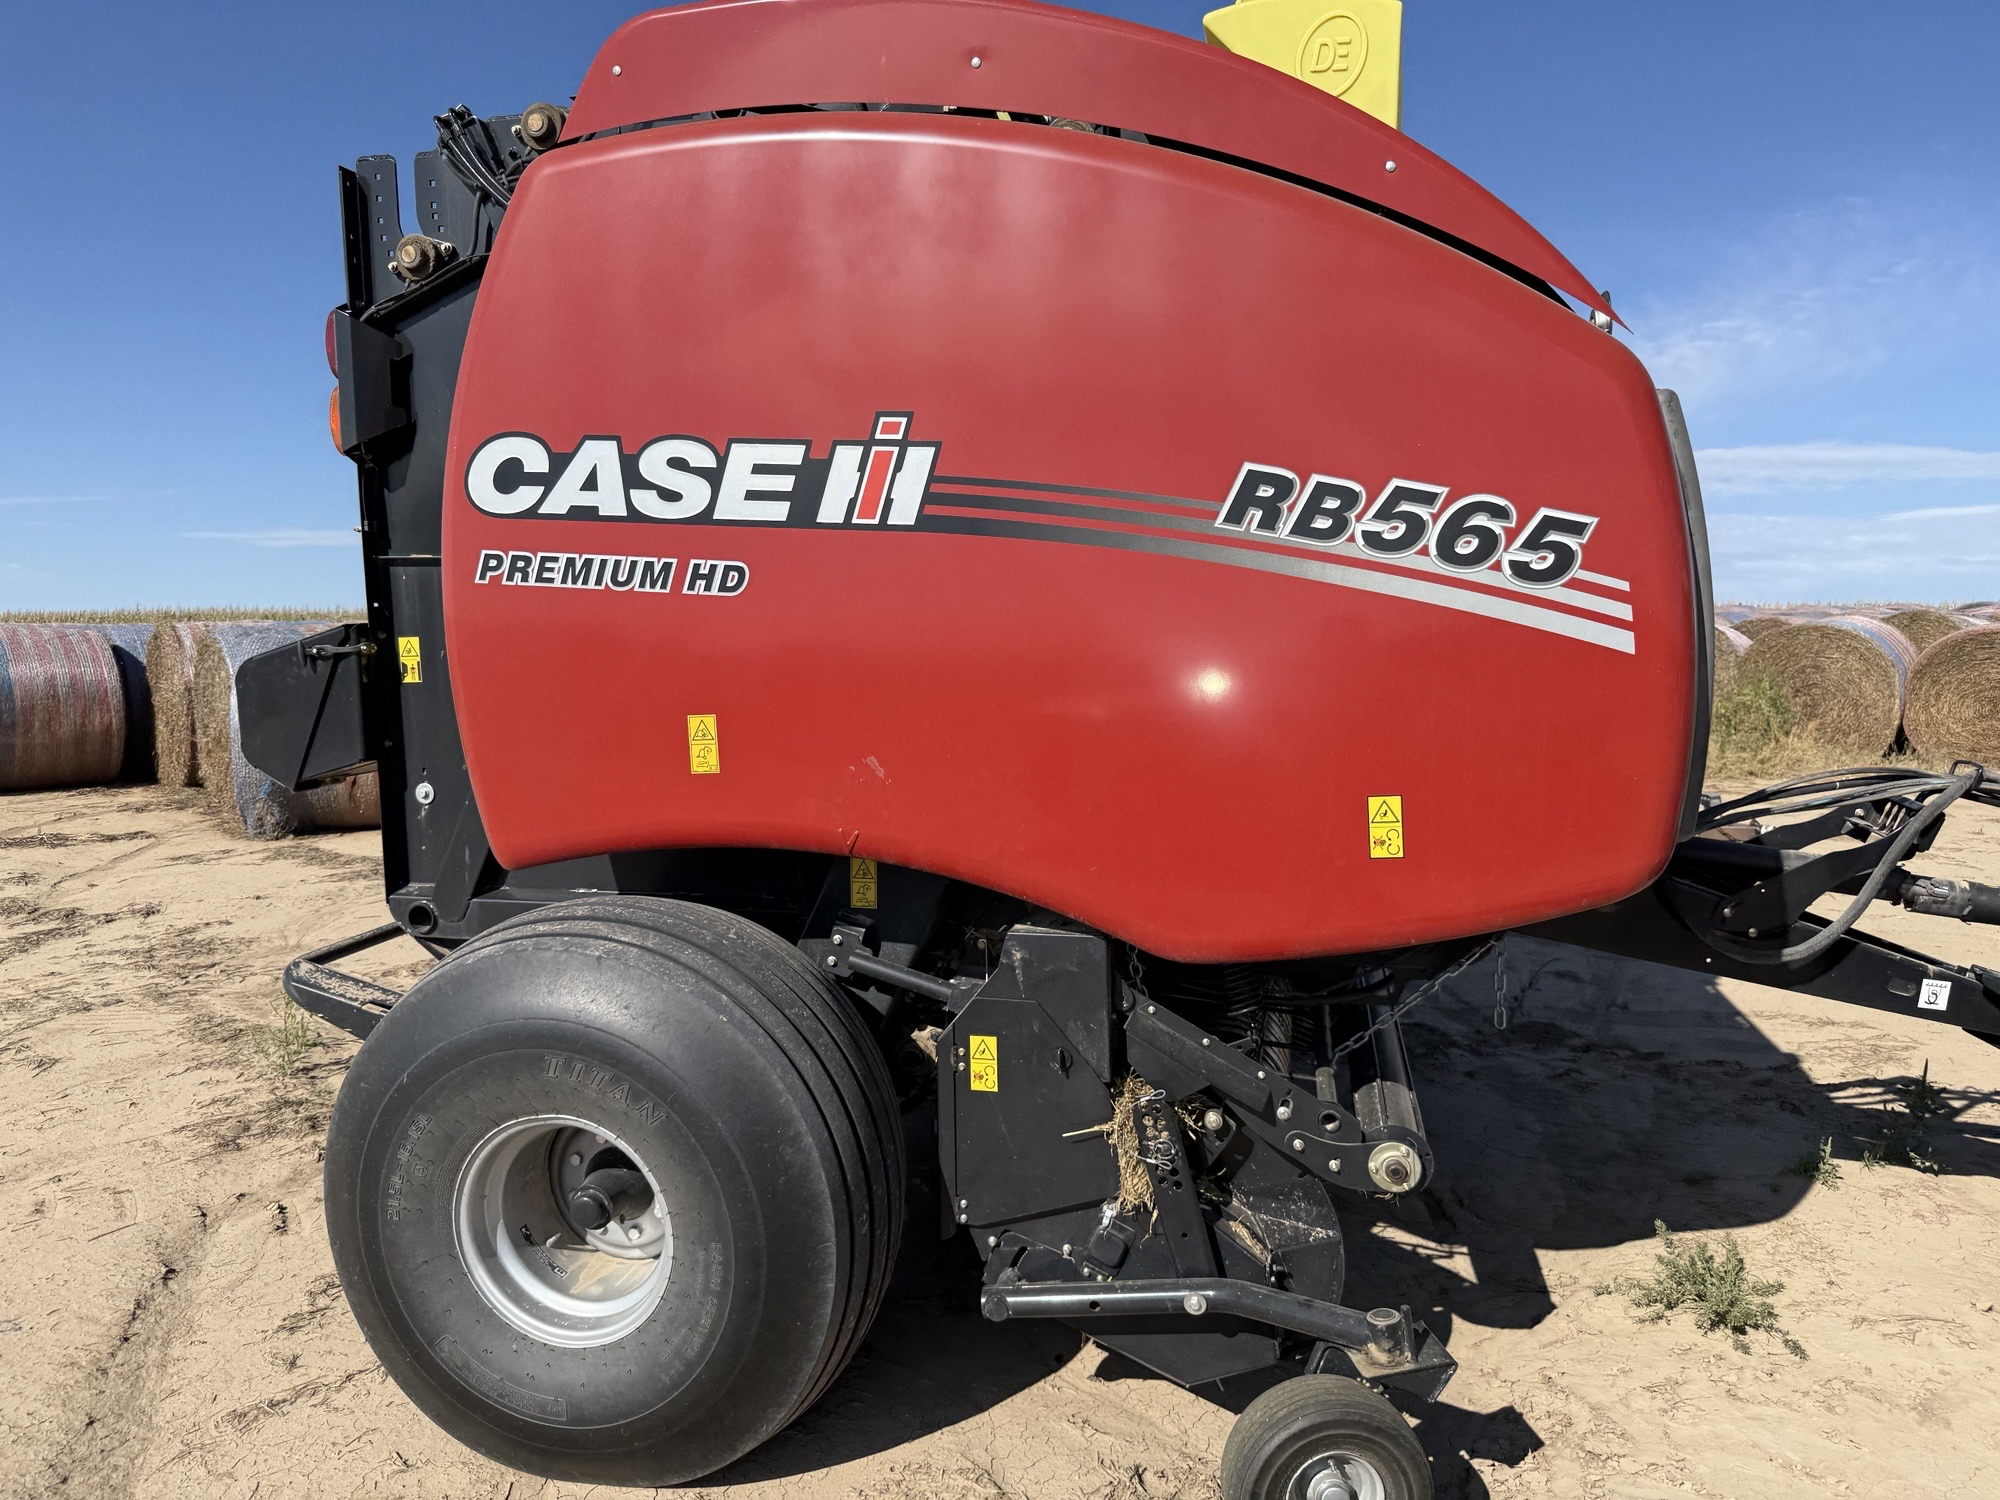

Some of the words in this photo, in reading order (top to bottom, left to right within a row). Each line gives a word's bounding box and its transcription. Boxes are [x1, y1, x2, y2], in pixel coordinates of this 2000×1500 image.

[1310, 36, 1352, 73] DE
[467, 435, 807, 521] CASE
[1214, 461, 1600, 589] RB565
[475, 549, 678, 594] PREMIUM
[682, 558, 750, 597] HD
[543, 1053, 668, 1125] TITAN
